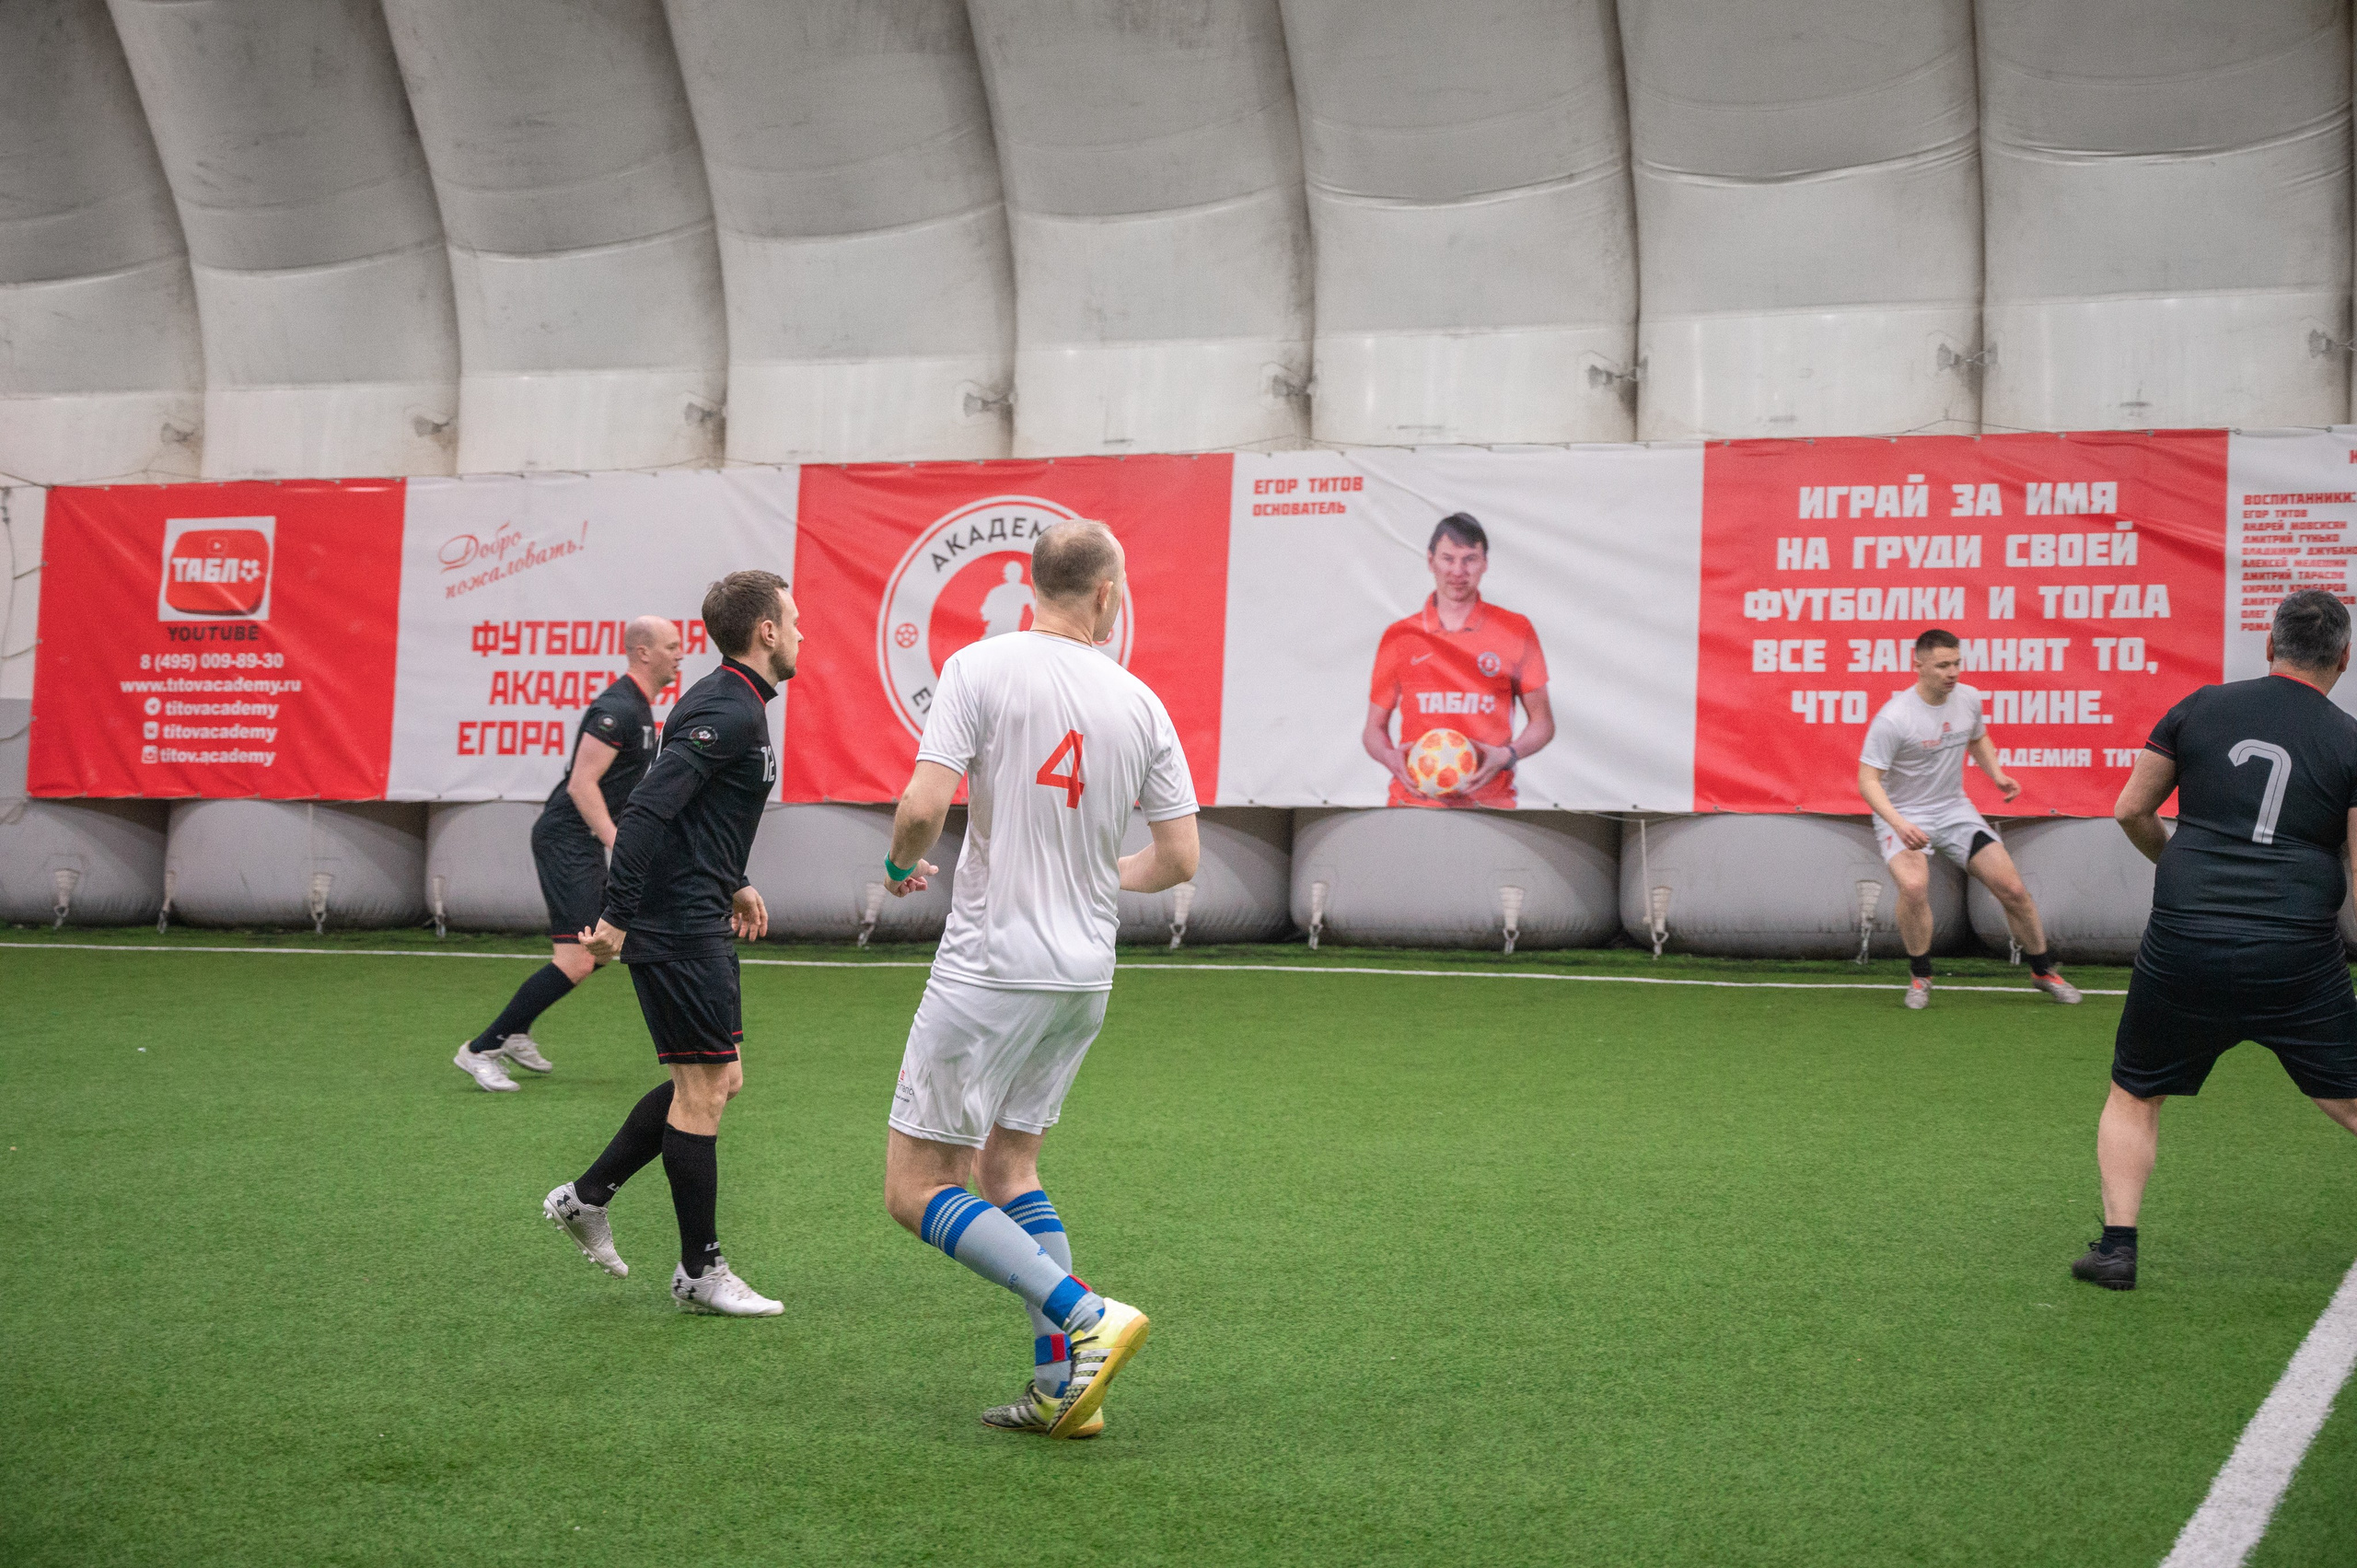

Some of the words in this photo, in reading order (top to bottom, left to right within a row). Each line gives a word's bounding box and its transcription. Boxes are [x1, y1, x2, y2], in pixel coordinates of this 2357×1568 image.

[1254, 479, 1298, 494] ЕГОР
[1308, 476, 1364, 493] ТИТОВ
[1799, 474, 1929, 519] ИГРАЙ
[1951, 483, 2003, 517] ЗА
[2026, 481, 2118, 516] ИМЯ
[1253, 502, 1346, 517] ОСНОВАТЕЛЬ
[2243, 510, 2269, 518] ЕГОР
[2274, 509, 2307, 517] ТИТОВ
[2243, 519, 2284, 531] АНДРЕЙ
[1776, 537, 1830, 570] НА
[1852, 535, 1982, 569] ГРУДИ
[2005, 521, 2139, 567] СВОЕЙ
[2242, 531, 2293, 543] ДМИТРИЙ
[437, 521, 522, 574] Добро
[446, 520, 588, 598] пожаловать!
[2242, 568, 2292, 580] ДМИТРИЙ
[1743, 587, 1965, 621] ФУТБОЛКИ
[1989, 586, 2015, 620] И
[2038, 584, 2171, 619] ТОГДА
[168, 624, 260, 642] YOUTUBE
[140, 655, 151, 669] 8
[156, 654, 197, 671] (495)
[201, 654, 284, 669] 009-89-30
[1752, 639, 1827, 672] ВСЕ
[1848, 638, 2071, 673] ЗАПМНЯТ
[2092, 637, 2159, 675] ТО,
[121, 679, 302, 694] www.titovacademy.ru
[165, 701, 279, 719] titovacademy
[1791, 691, 1868, 724] ЧТО
[163, 725, 278, 743] titovacademy
[458, 722, 565, 756] ЕГОРА
[160, 749, 275, 766] titov.academy
[1036, 728, 1086, 810] 4
[2228, 738, 2292, 844] 7
